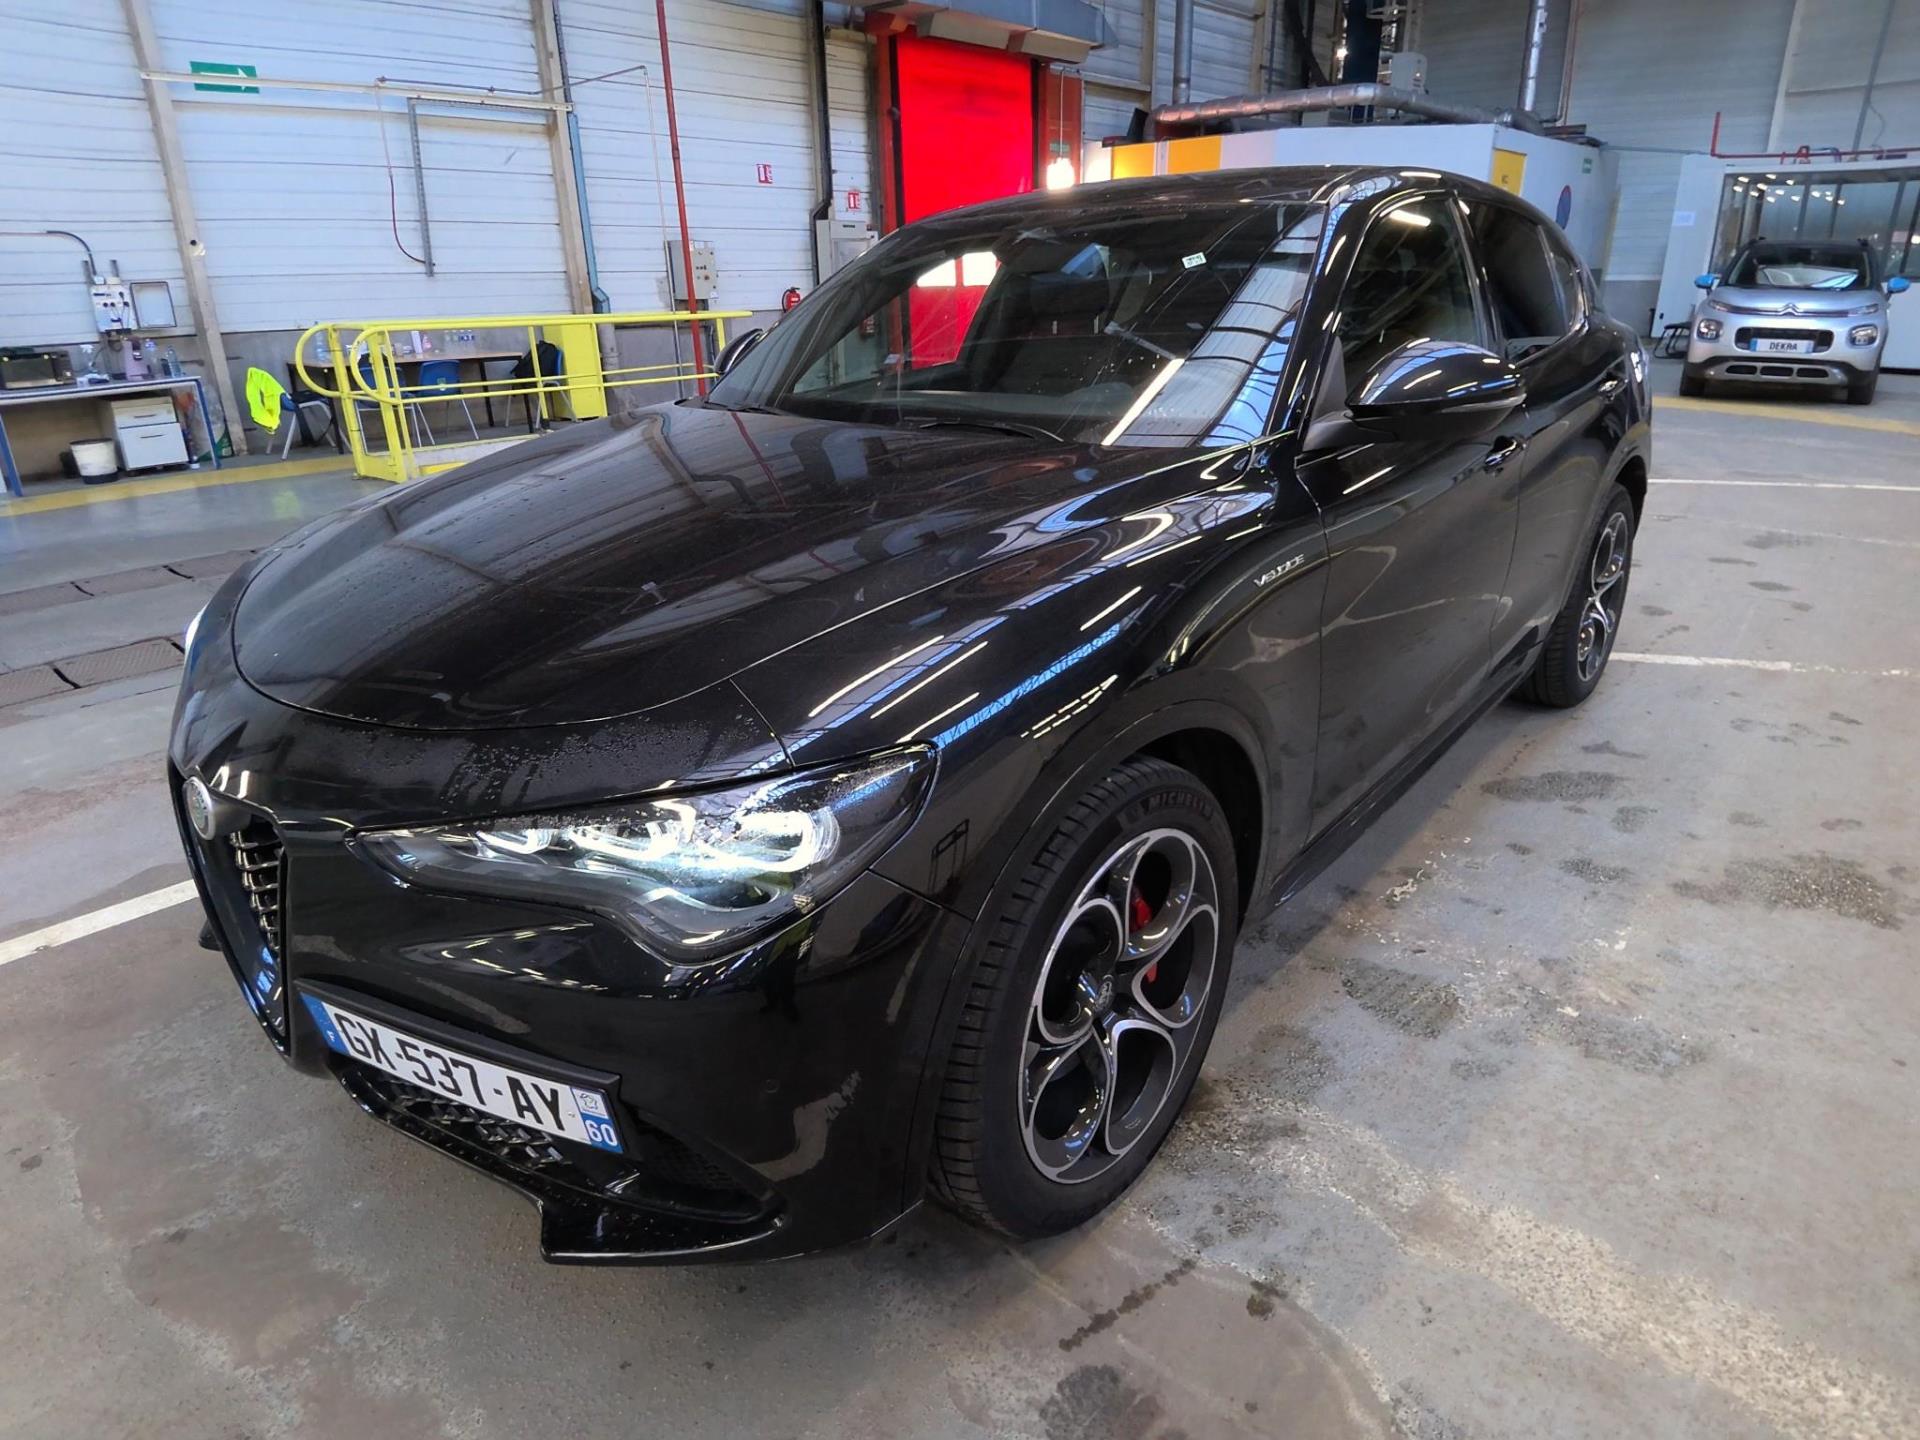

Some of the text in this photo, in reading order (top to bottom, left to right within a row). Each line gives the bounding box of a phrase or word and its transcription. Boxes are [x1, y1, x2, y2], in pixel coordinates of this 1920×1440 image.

[1769, 341, 1798, 351] DEKRA
[1149, 790, 1214, 820] MICHELIN
[333, 1012, 565, 1132] GX-537-AY
[584, 1119, 618, 1147] 60
